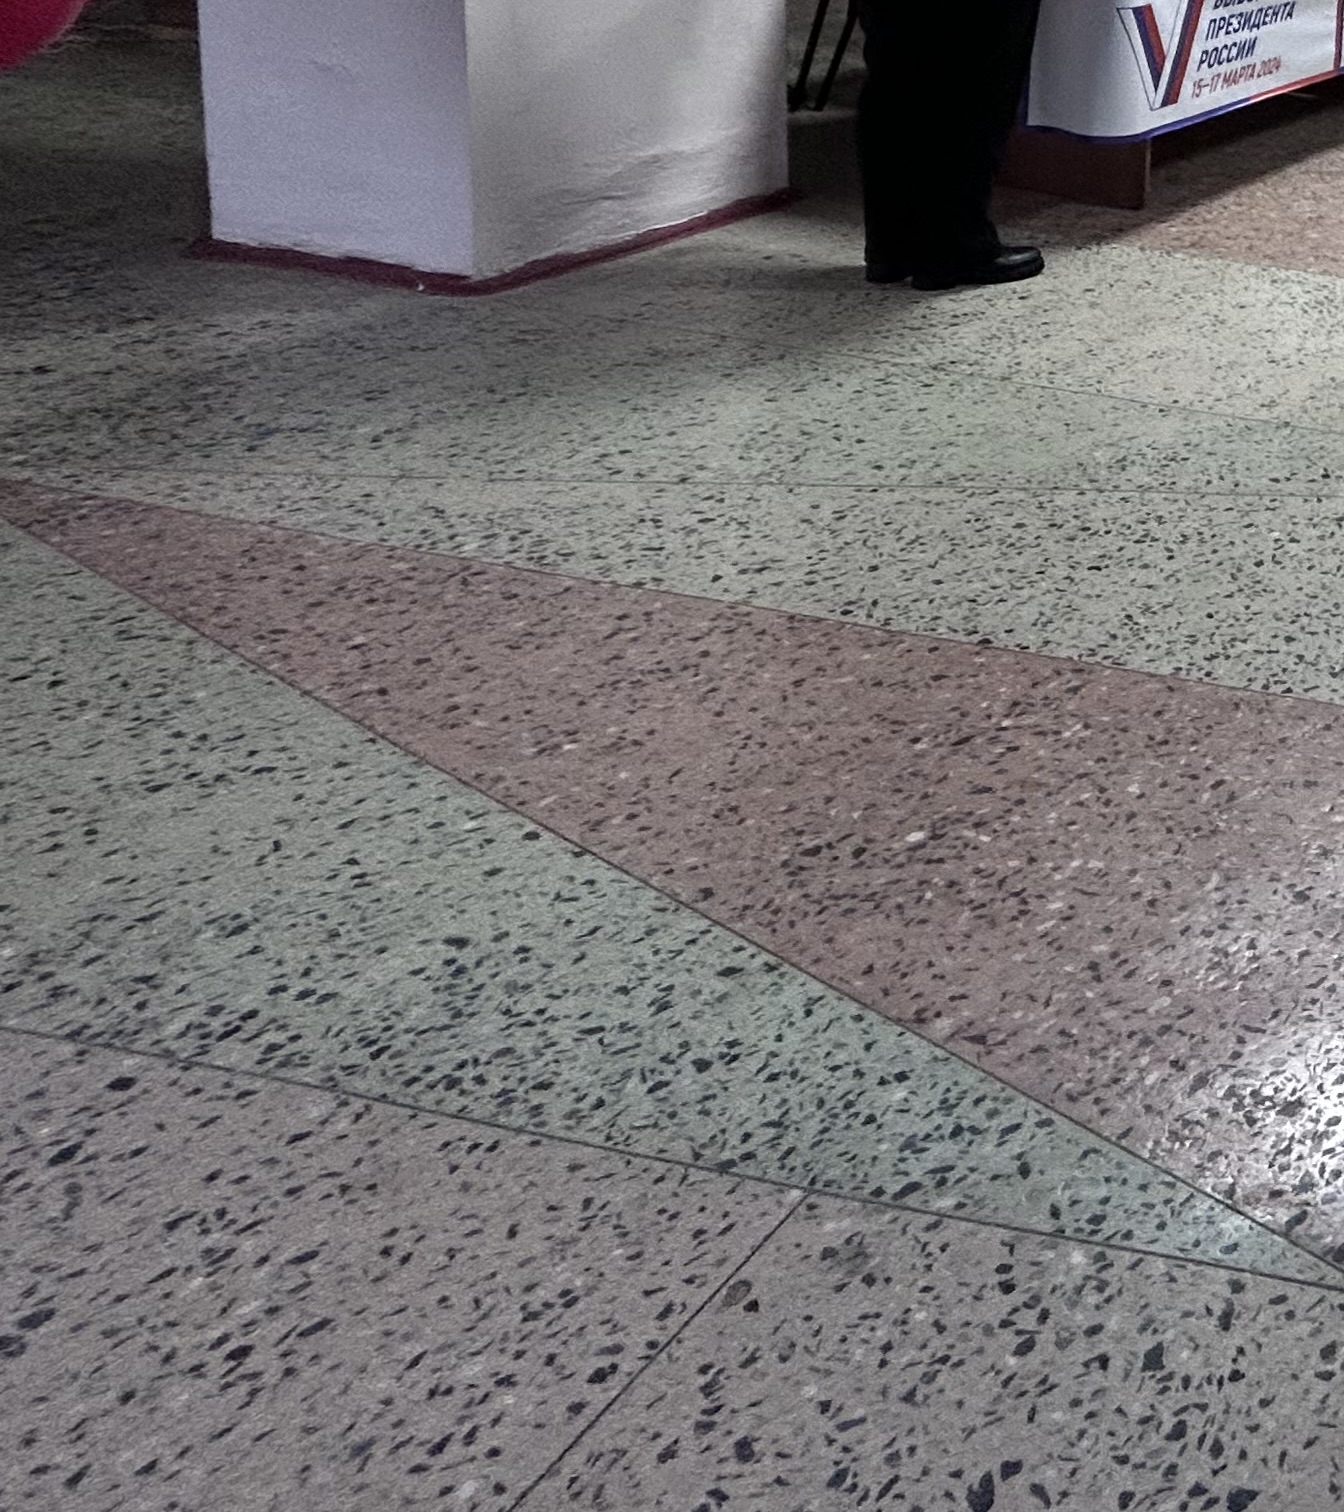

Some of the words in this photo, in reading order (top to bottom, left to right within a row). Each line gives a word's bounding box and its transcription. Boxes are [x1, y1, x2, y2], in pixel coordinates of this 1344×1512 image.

[1205, 1, 1296, 41] ПРЕЗИДЕНТА
[1196, 36, 1258, 72] РОССИИ
[1220, 62, 1257, 90] МАРТА
[1256, 56, 1282, 79] 2024
